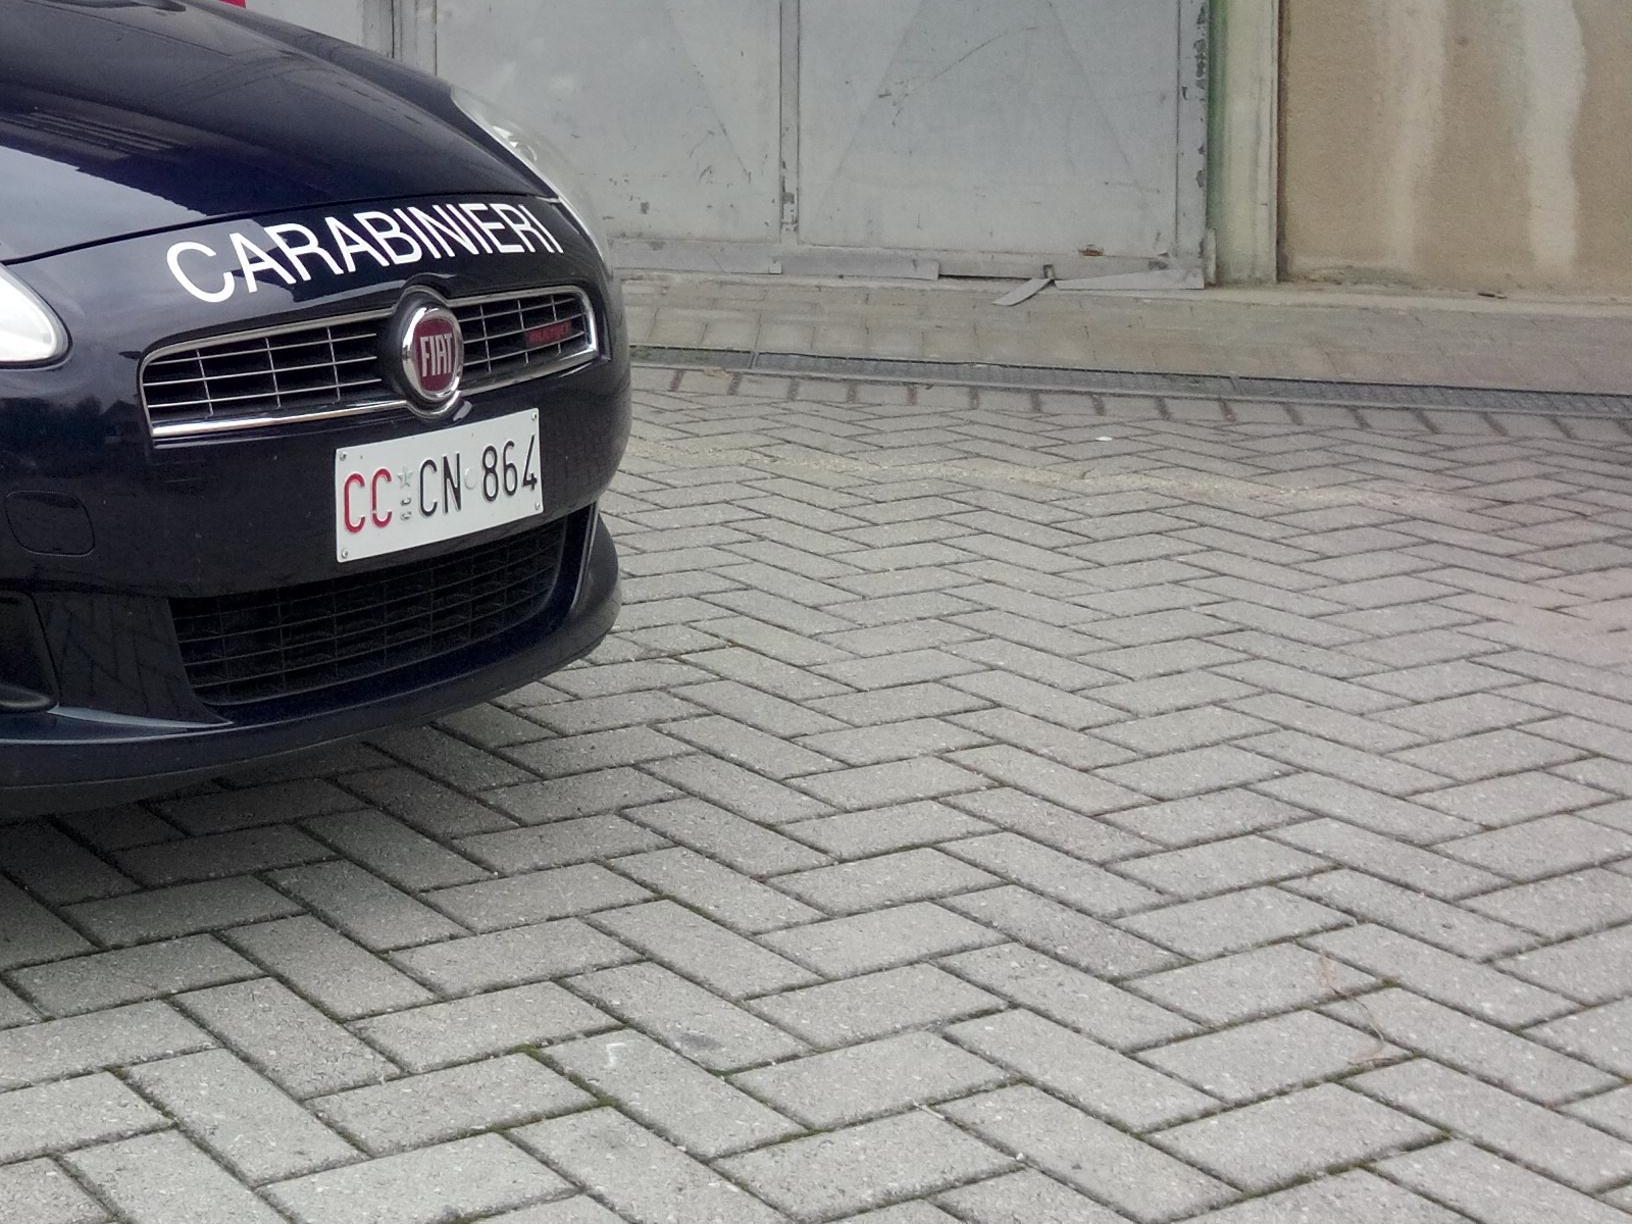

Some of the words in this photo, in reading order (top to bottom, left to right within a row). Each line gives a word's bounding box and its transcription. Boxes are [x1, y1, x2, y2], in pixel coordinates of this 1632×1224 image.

[166, 202, 564, 303] CARABINIERI
[419, 333, 454, 377] FIAT
[343, 467, 393, 533] CC
[419, 452, 462, 516] CN
[482, 434, 538, 502] 864
